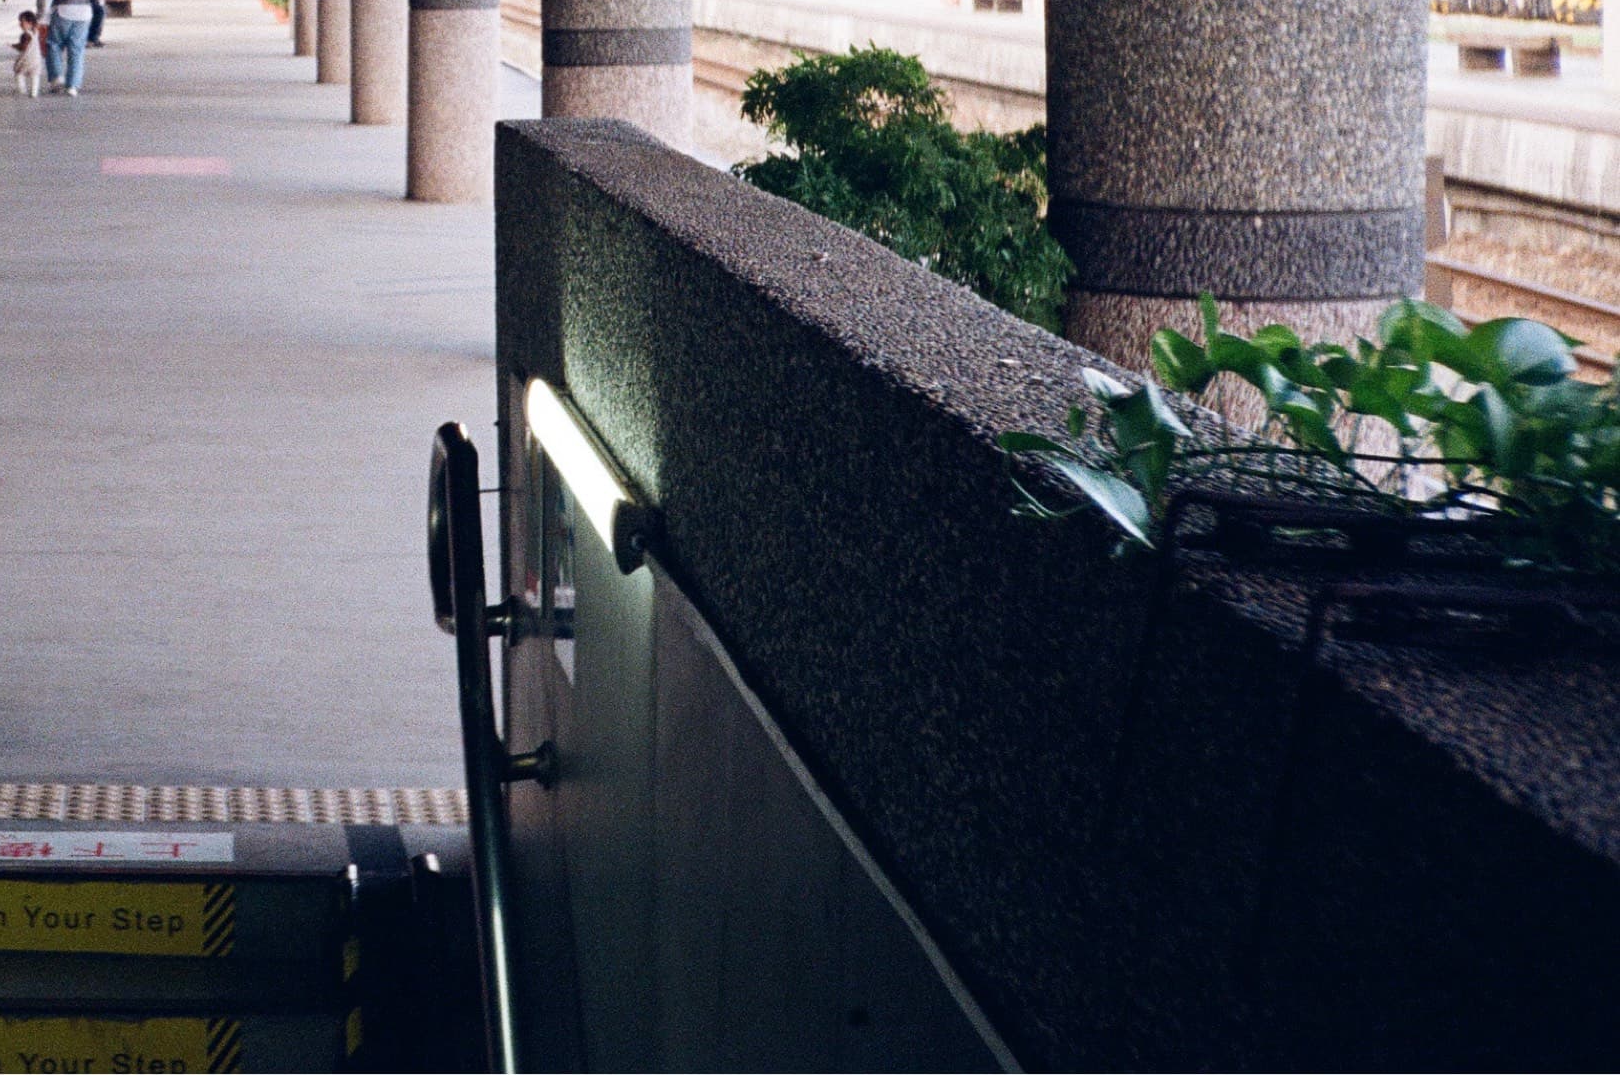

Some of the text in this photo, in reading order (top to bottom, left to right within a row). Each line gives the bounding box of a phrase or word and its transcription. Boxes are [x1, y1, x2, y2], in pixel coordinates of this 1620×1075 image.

[23, 905, 98, 930] Your
[112, 907, 186, 937] Step
[16, 1052, 96, 1073] Your
[111, 1052, 188, 1073] Step
